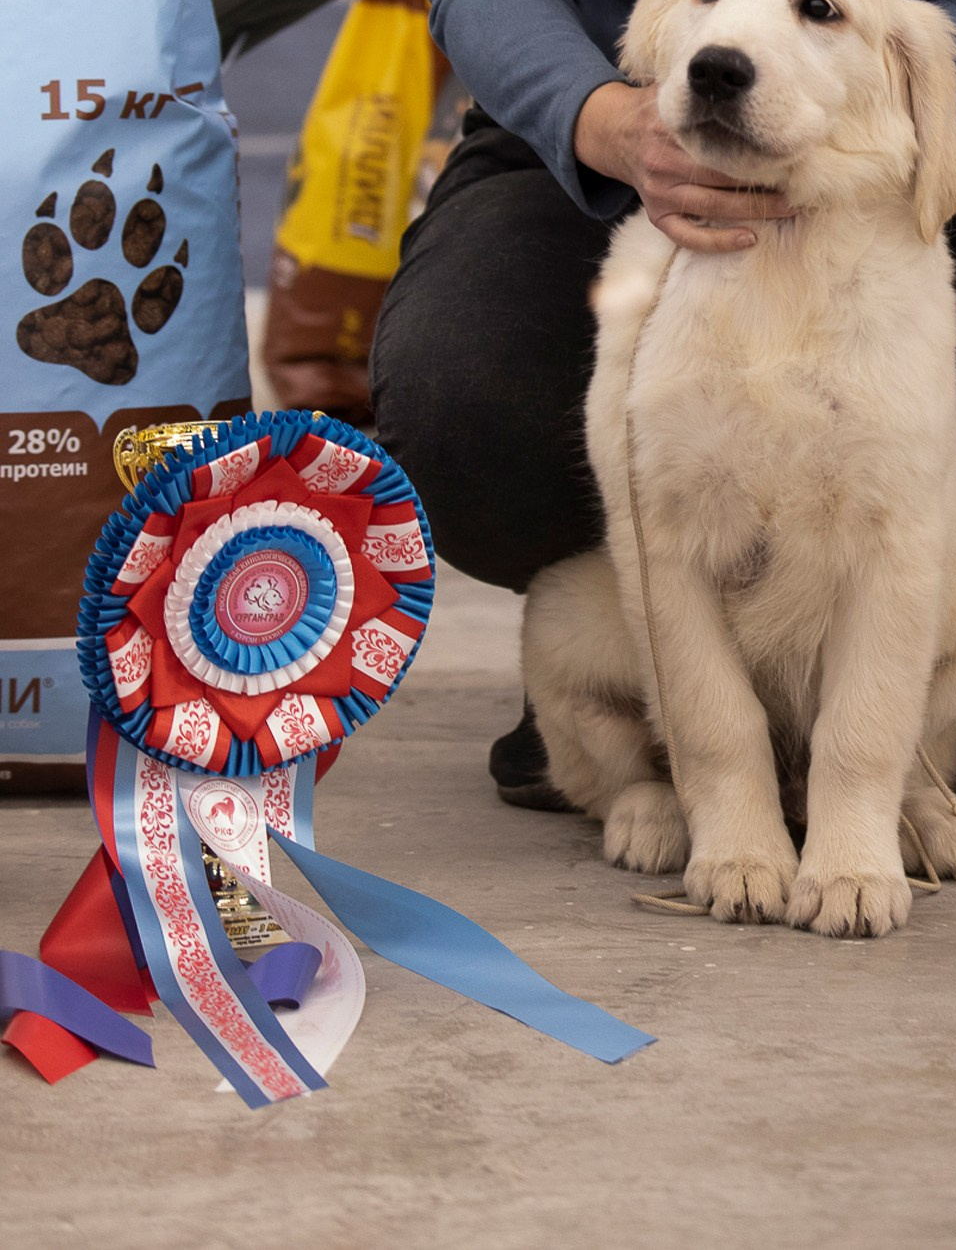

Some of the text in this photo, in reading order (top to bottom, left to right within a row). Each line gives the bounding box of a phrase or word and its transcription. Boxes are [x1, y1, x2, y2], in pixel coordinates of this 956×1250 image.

[40, 79, 204, 120] 15 кг
[8, 429, 80, 455] 28%
[0, 462, 88, 482] протеин
[214, 826, 234, 837] РКФ
